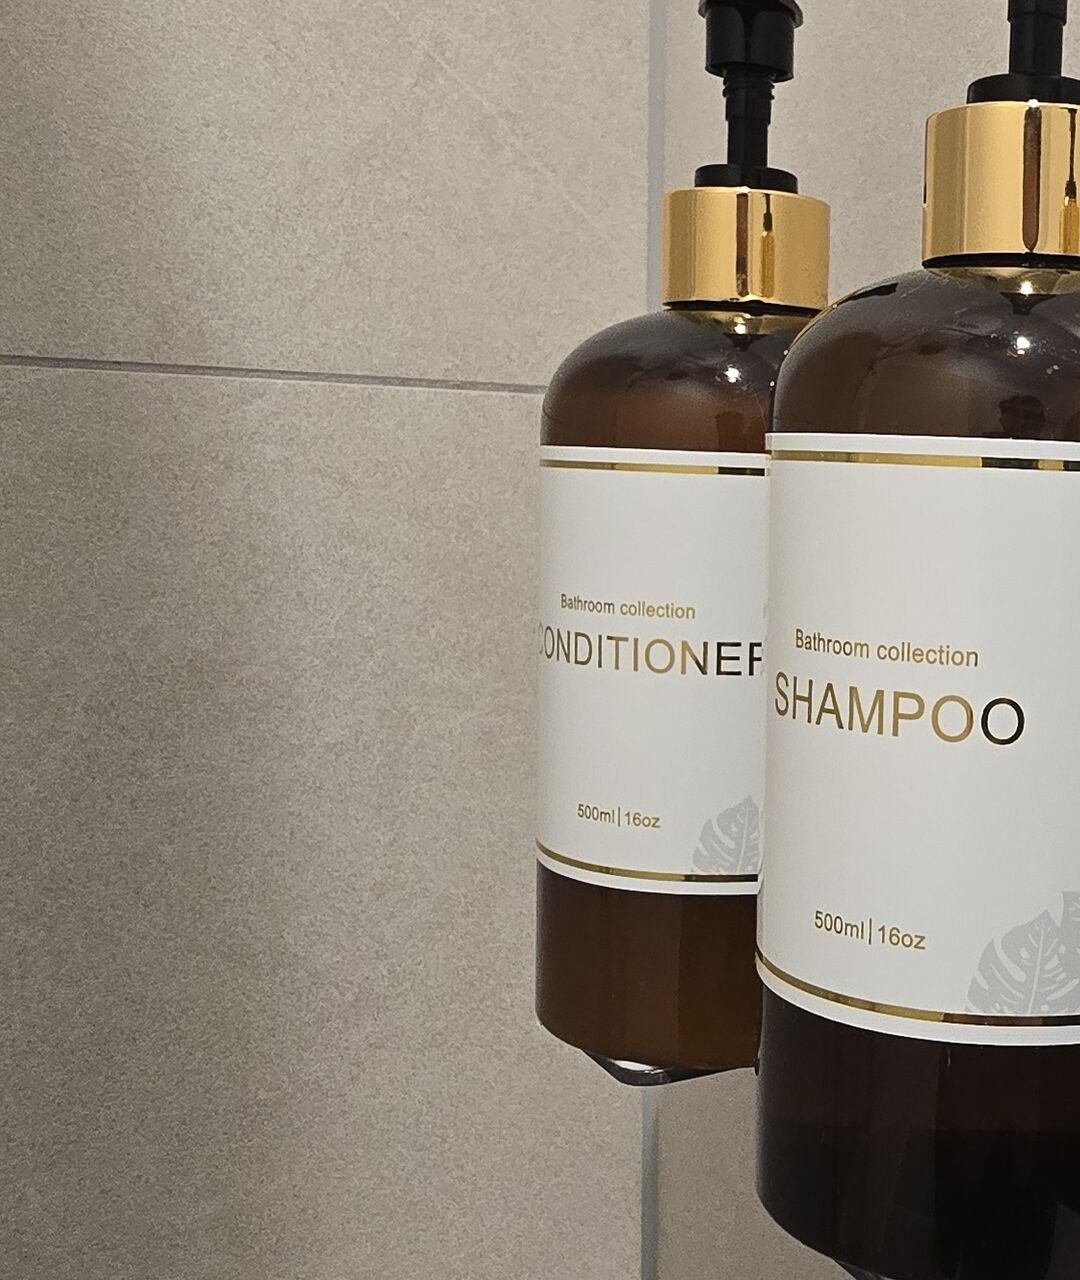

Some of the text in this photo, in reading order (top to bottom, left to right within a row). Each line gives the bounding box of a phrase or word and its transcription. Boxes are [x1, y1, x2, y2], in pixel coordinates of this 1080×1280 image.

[560, 593, 696, 620] Bathroom collection
[795, 627, 979, 668] Bathroom collection
[774, 671, 1026, 746] SHAMPOO
